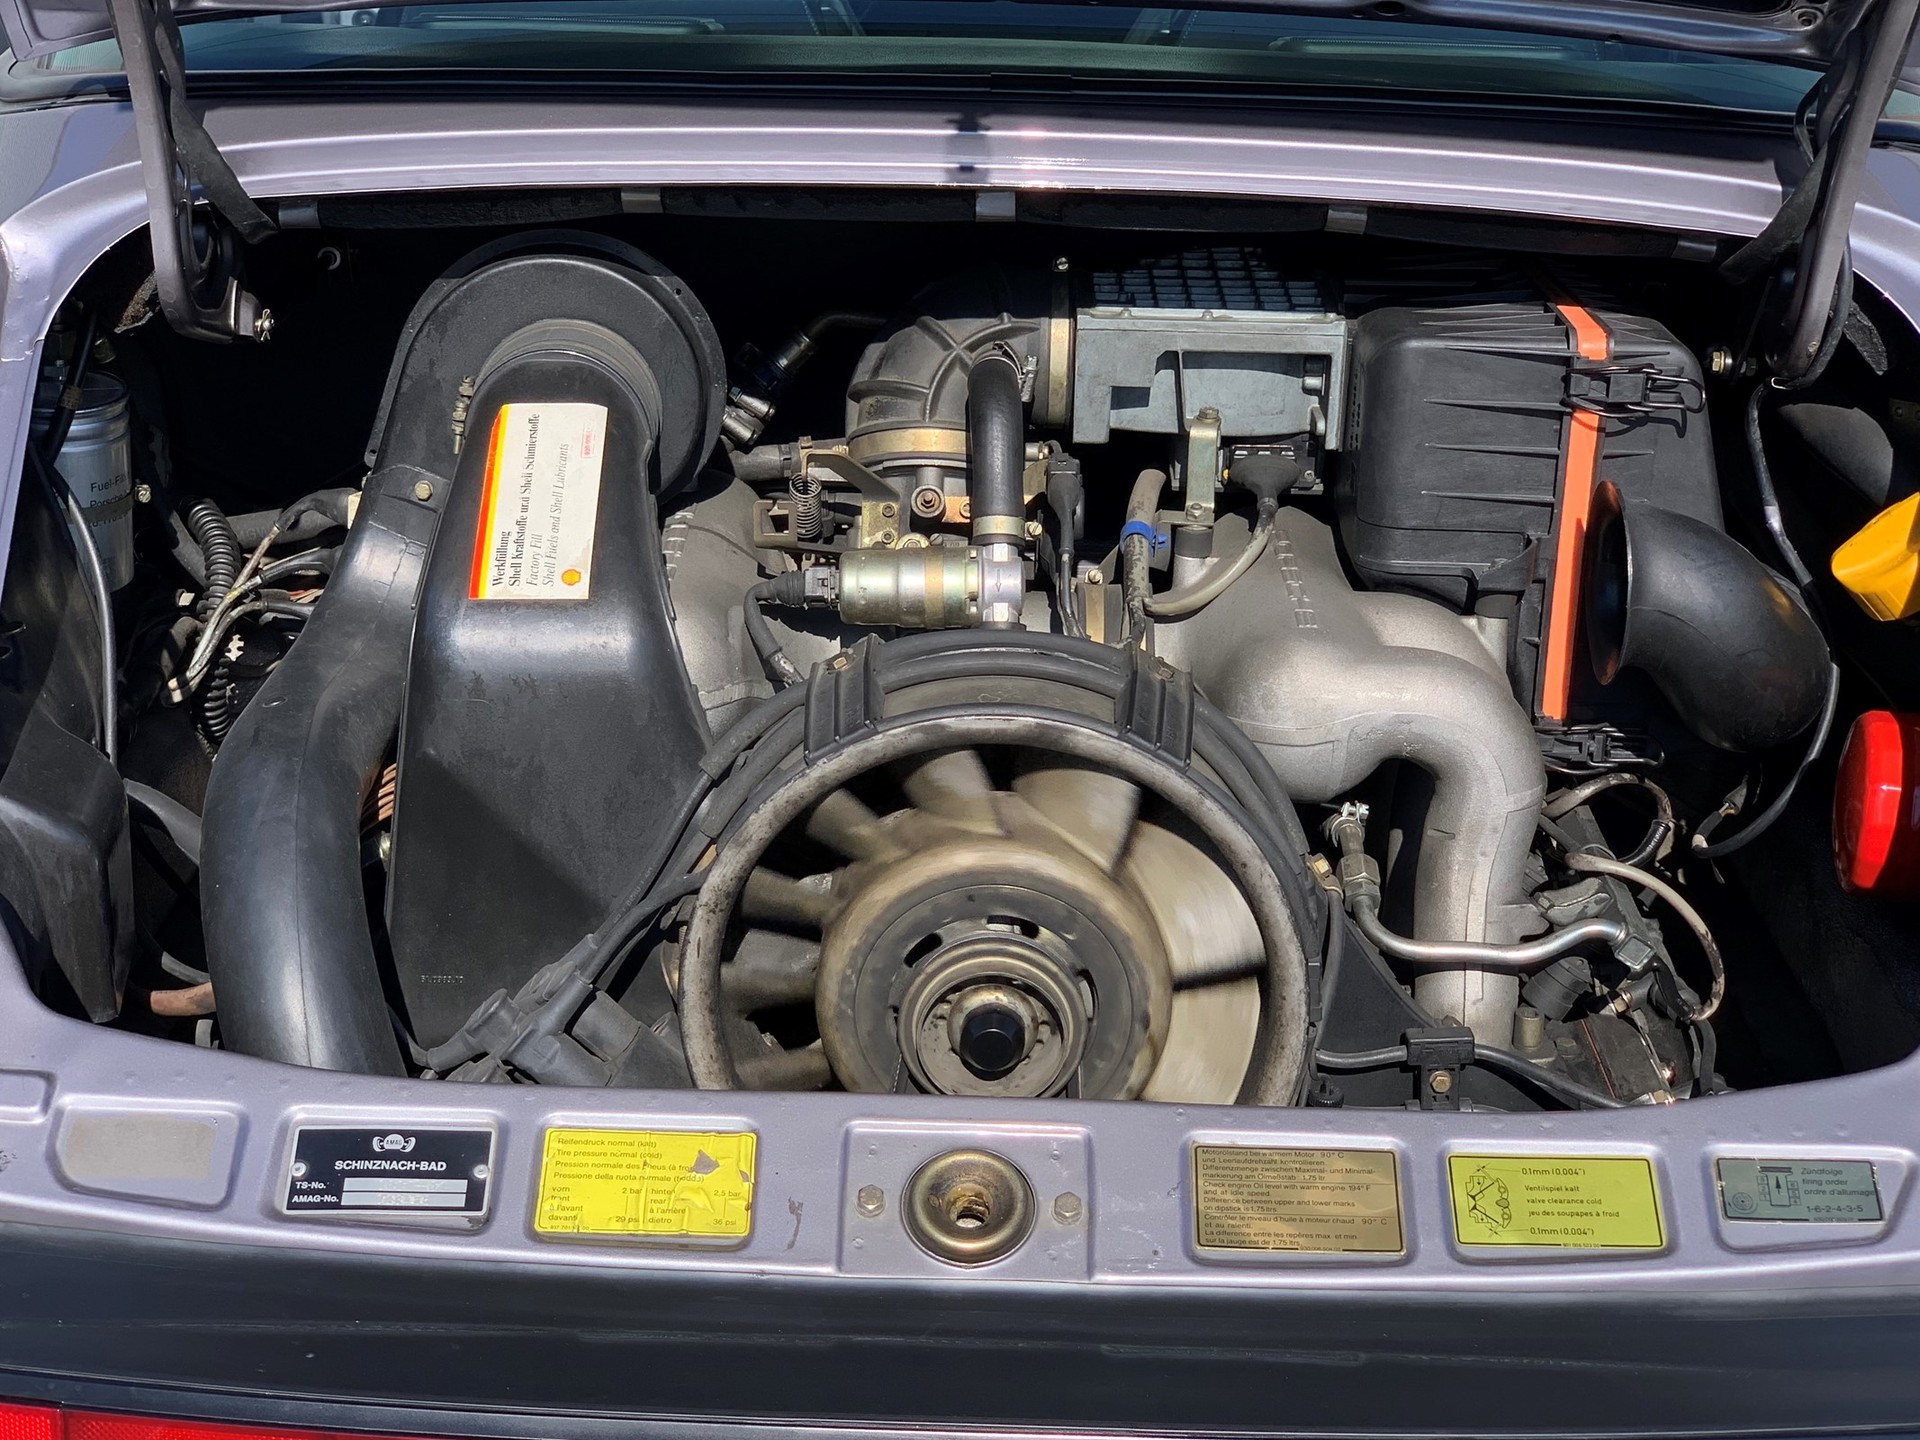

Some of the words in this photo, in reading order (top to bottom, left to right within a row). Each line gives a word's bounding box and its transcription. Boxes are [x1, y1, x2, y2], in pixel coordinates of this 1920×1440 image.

[523, 414, 540, 470] Schmierstoffe
[553, 443, 569, 489] Lubricants
[520, 472, 533, 494] Shell
[520, 497, 530, 513] und
[551, 492, 564, 514] Shell
[551, 516, 561, 533] and
[514, 515, 528, 559] Kraftstoffe
[530, 534, 542, 548] Fill
[547, 536, 558, 559] Fuels
[492, 531, 511, 586] Werkfüllung
[509, 563, 523, 586] Shell
[526, 552, 542, 586] Factory
[543, 563, 556, 586] Shell
[558, 1138, 605, 1146] Reifendruck
[608, 1139, 635, 1147] normal
[335, 1160, 446, 1171] SCHINZNACH-BAD
[1203, 1165, 1258, 1173] Differenzmenge
[1801, 1167, 1843, 1176] Zündfolge
[1203, 1173, 1243, 1181] markierung
[1228, 1182, 1254, 1190] engine
[1829, 1189, 1875, 1197] d'allumage
[292, 1195, 339, 1203] AMAG-No.
[649, 1206, 655, 1214] à
[1807, 1205, 1863, 1213] 1-6-2-4-3-5
[1226, 1238, 1247, 1246] jauge
